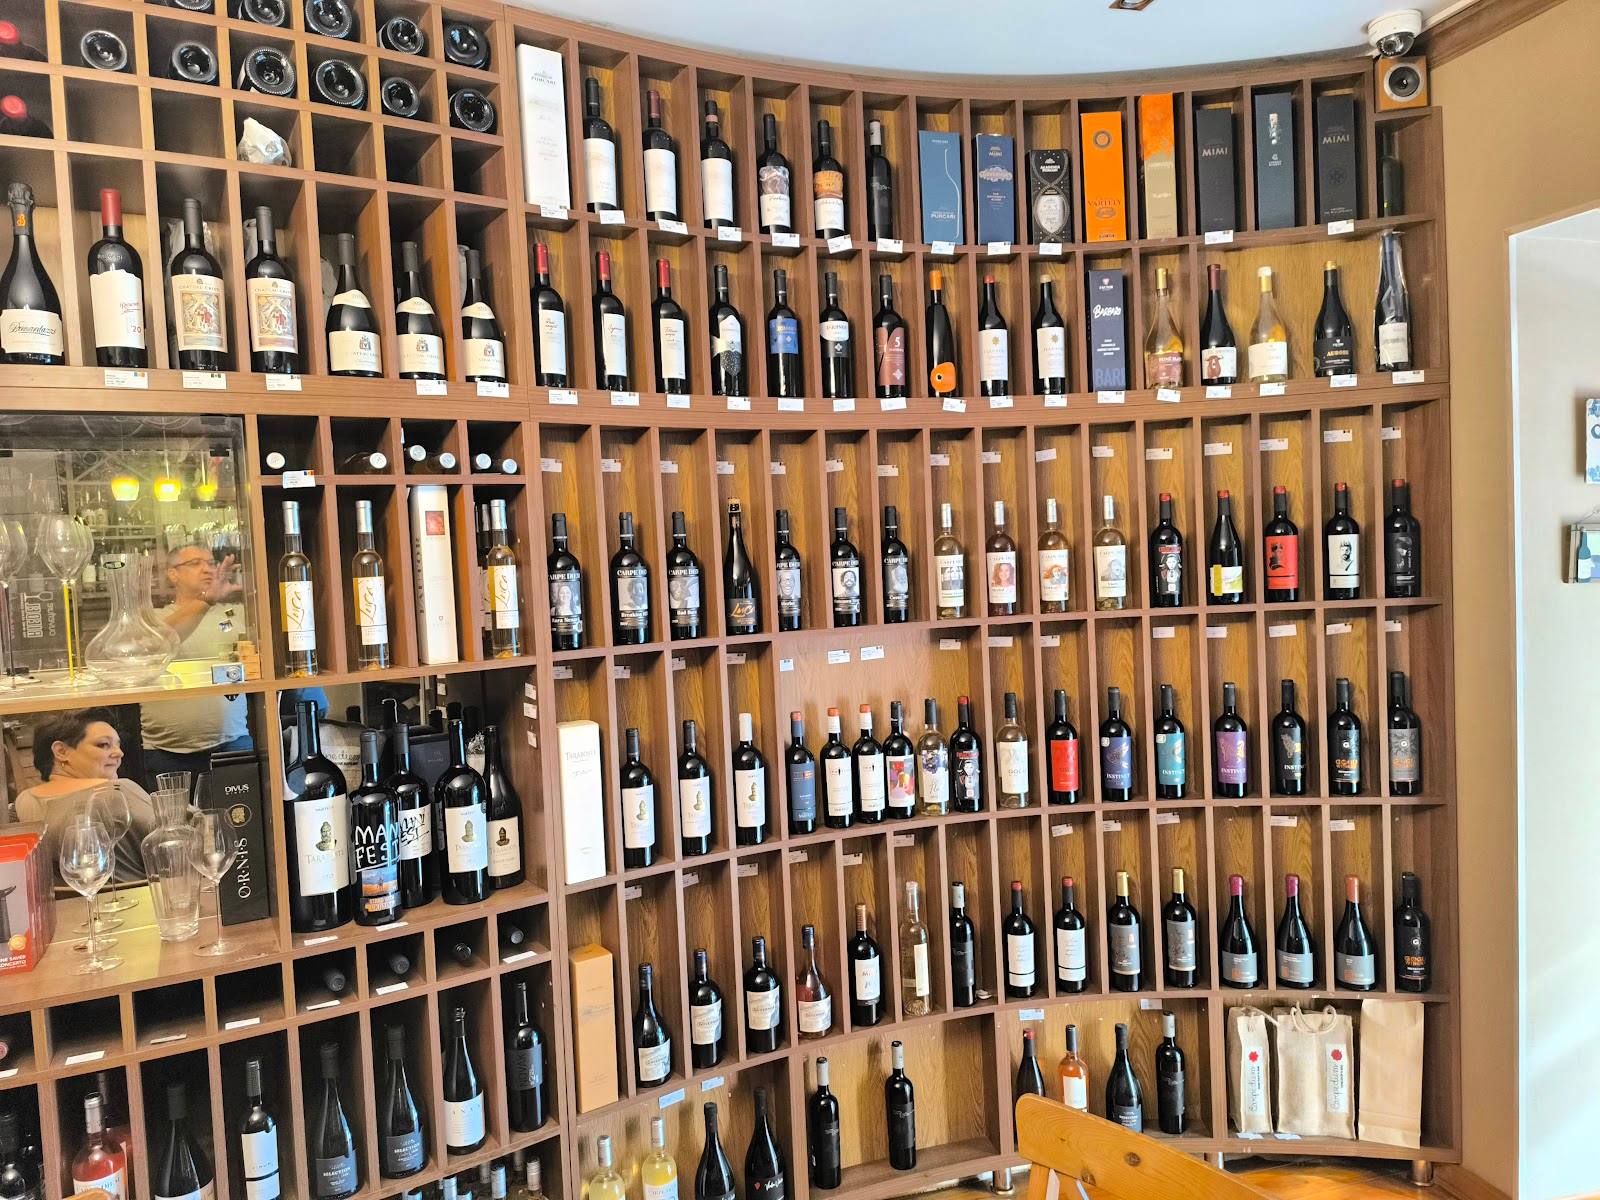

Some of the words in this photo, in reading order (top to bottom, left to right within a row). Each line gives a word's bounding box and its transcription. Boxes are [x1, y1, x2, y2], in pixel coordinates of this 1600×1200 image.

[1322, 134, 1350, 145] MIMI
[1202, 147, 1228, 157] MIMI
[894, 336, 901, 348] 5
[224, 783, 249, 793] DIVUS
[0, 960, 27, 969] ONCERTO
